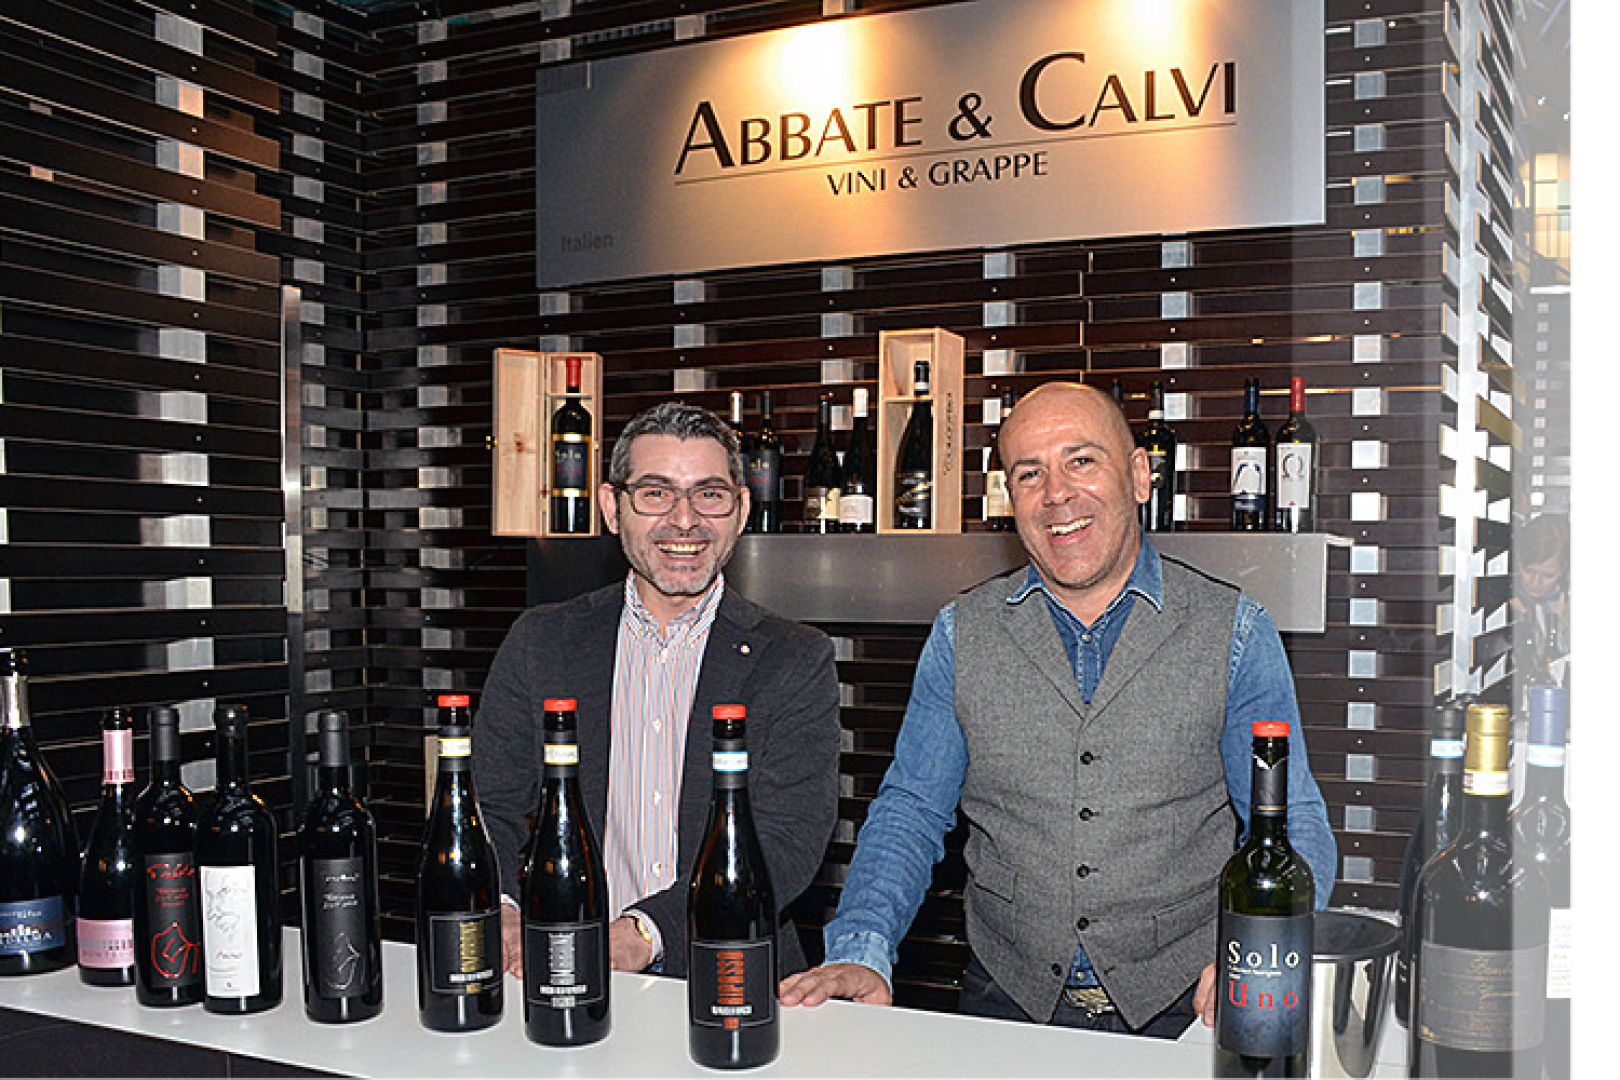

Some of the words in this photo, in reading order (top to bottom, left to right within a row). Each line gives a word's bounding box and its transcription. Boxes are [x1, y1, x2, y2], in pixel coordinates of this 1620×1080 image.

[674, 97, 922, 175] ABBATE
[948, 92, 993, 141] &
[1018, 51, 1237, 132] CALVI
[827, 168, 886, 196] VINI
[898, 166, 919, 190] &
[928, 151, 1049, 186] GRAPPE
[560, 230, 614, 251] Italien
[1228, 941, 1300, 969] Solo
[1228, 979, 1299, 1010] Uno
